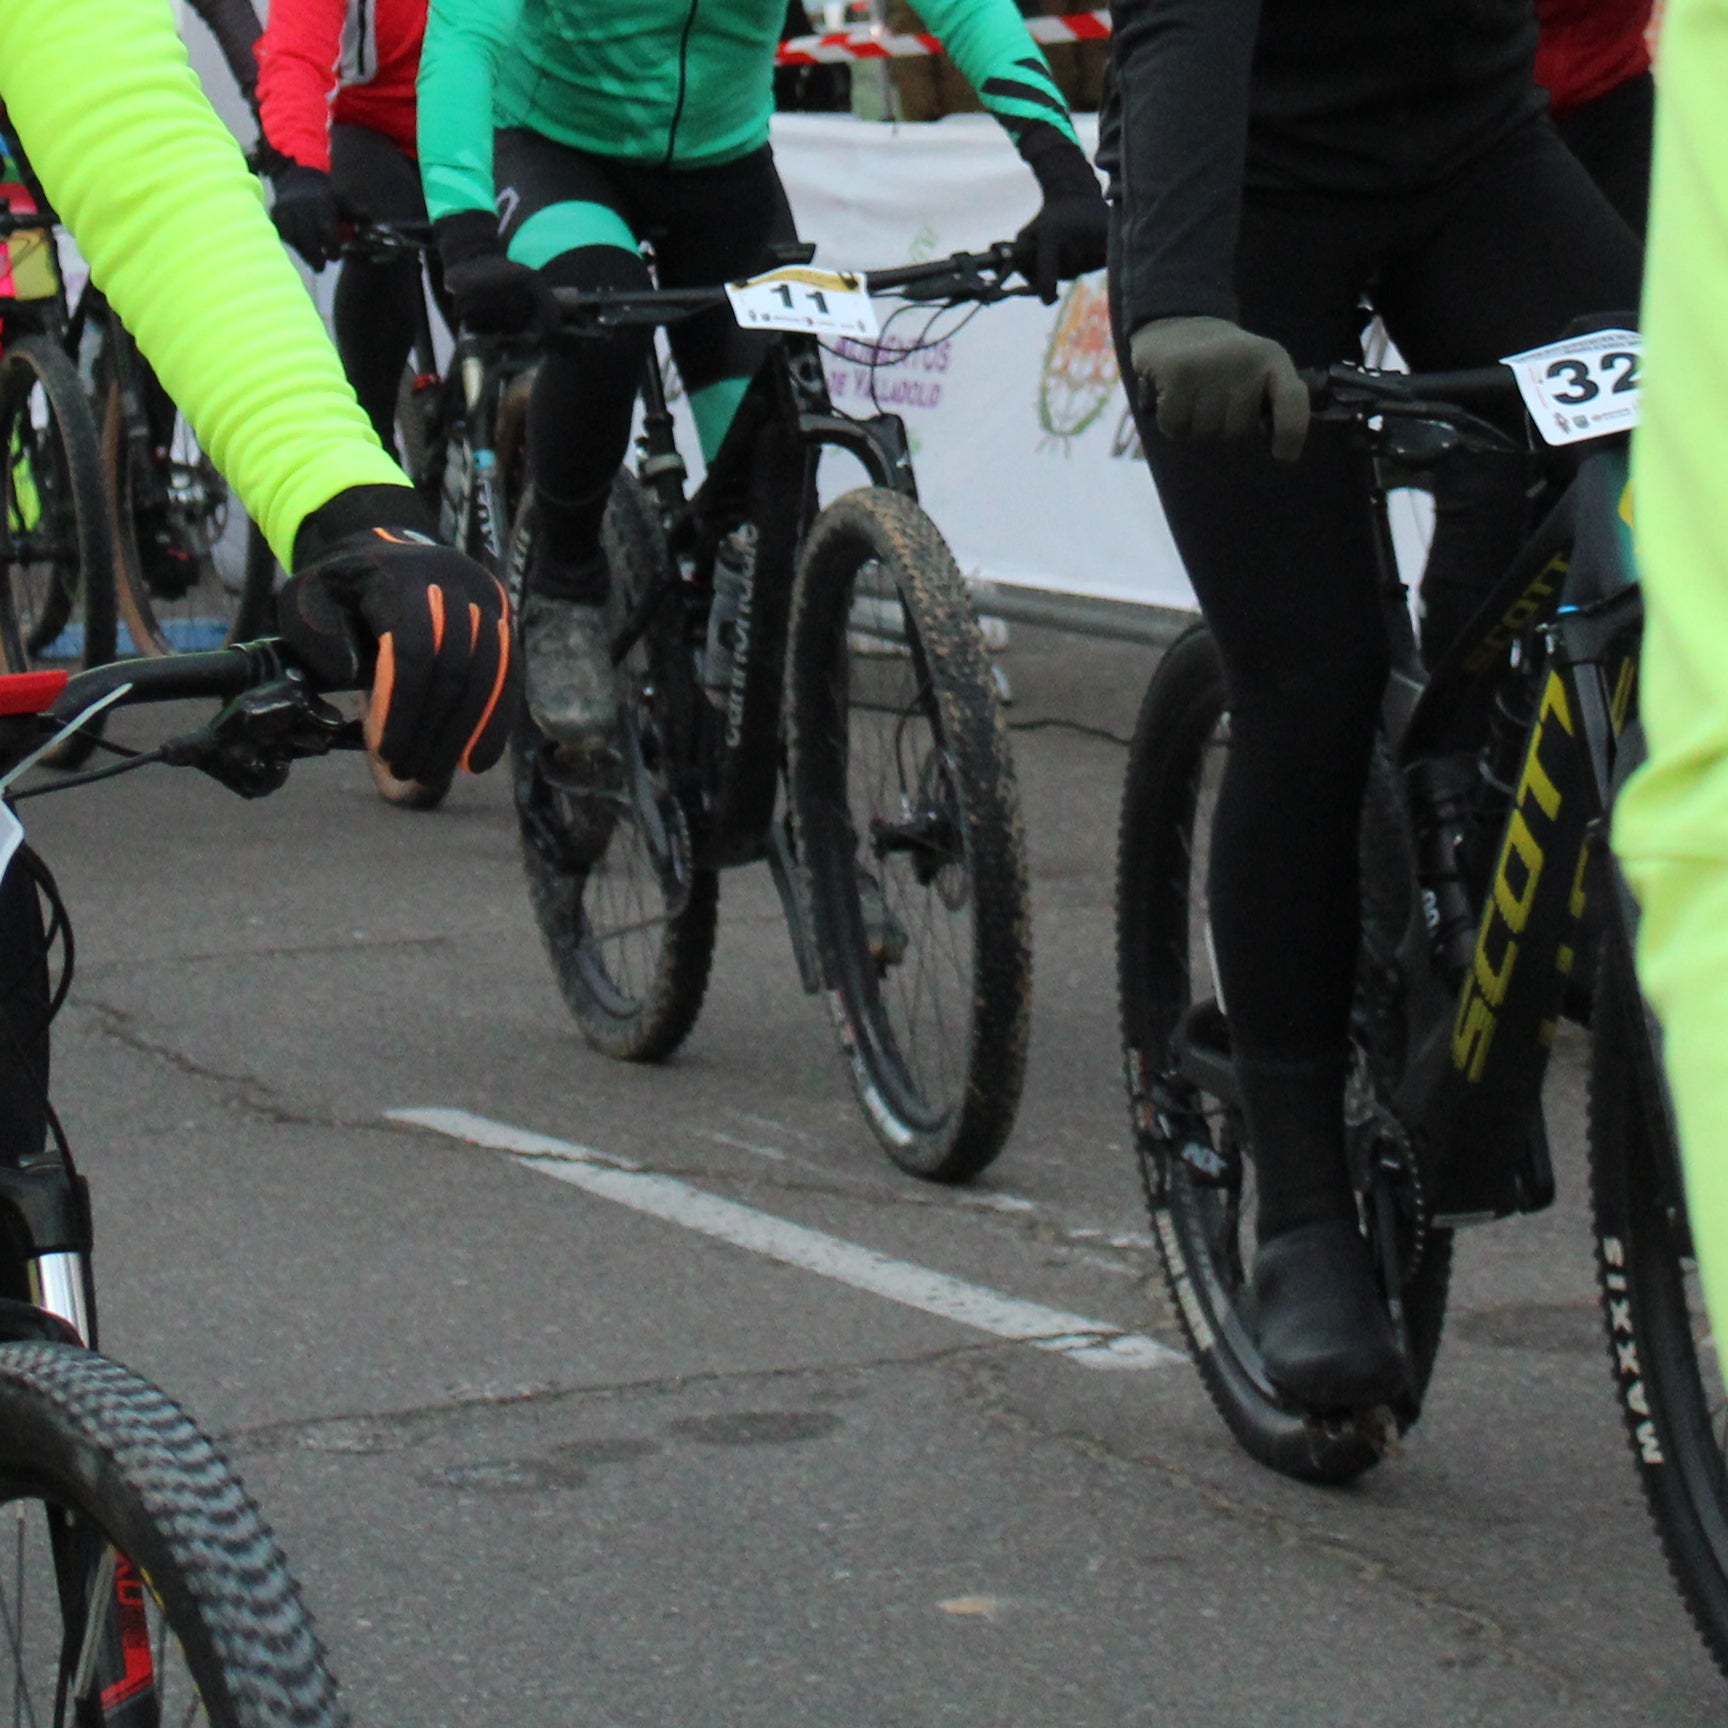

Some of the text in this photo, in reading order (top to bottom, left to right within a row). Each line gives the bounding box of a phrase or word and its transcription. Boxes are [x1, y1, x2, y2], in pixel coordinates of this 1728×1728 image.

[770, 283, 830, 315] 11
[1451, 669, 1574, 1082] SCOTT
[1603, 1236, 1665, 1465] MAXXIS
